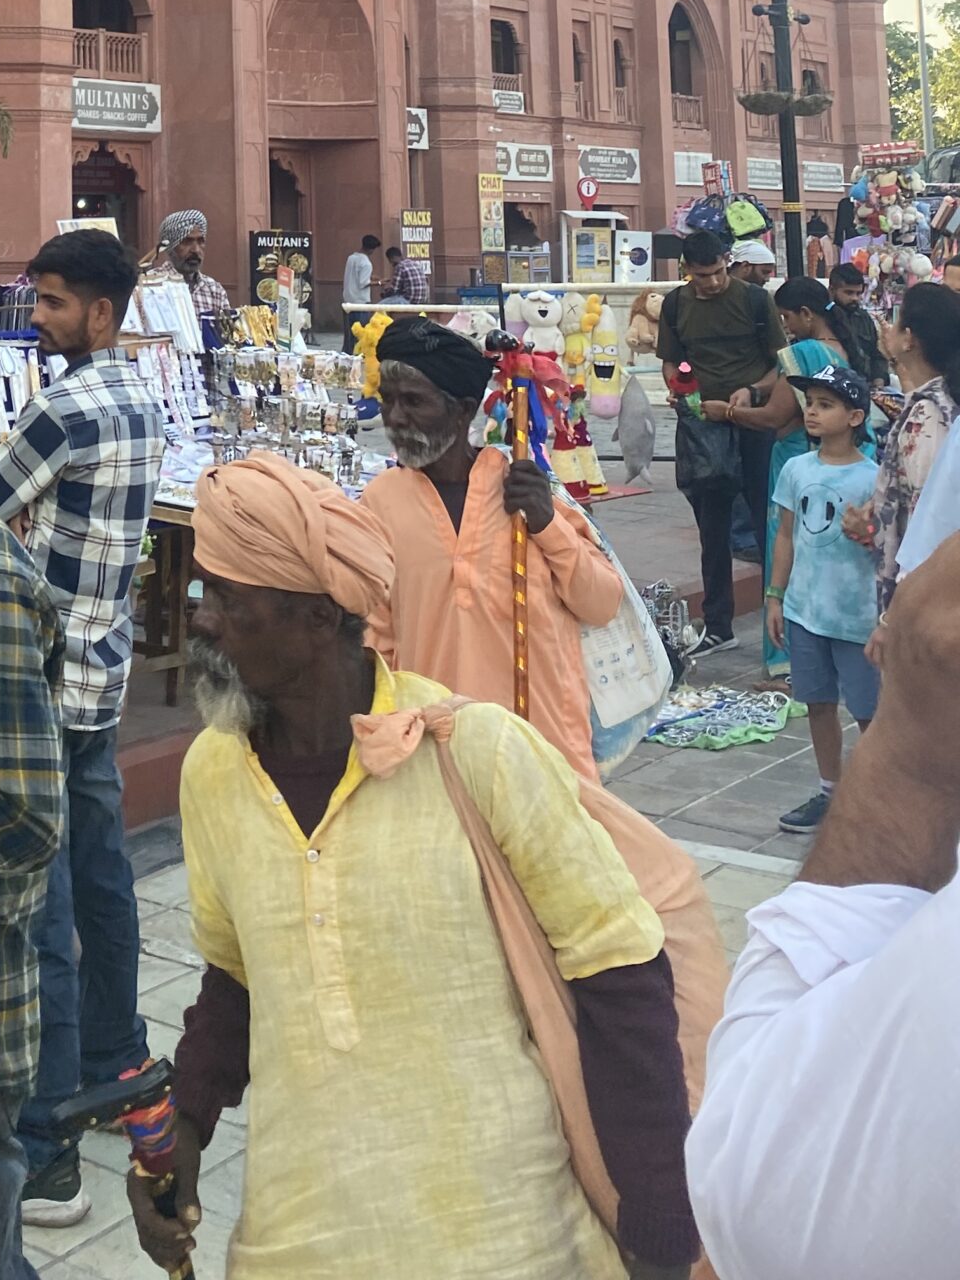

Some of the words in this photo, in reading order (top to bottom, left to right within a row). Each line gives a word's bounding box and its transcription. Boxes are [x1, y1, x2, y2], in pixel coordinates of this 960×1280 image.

[75, 88, 150, 110] MULTANI'S
[480, 176, 502, 190] CHAT
[403, 210, 431, 226] SNACKS
[257, 236, 310, 248] MULTANI'S
[402, 227, 433, 242] BREAKFAST
[406, 243, 430, 258] LUNCH
